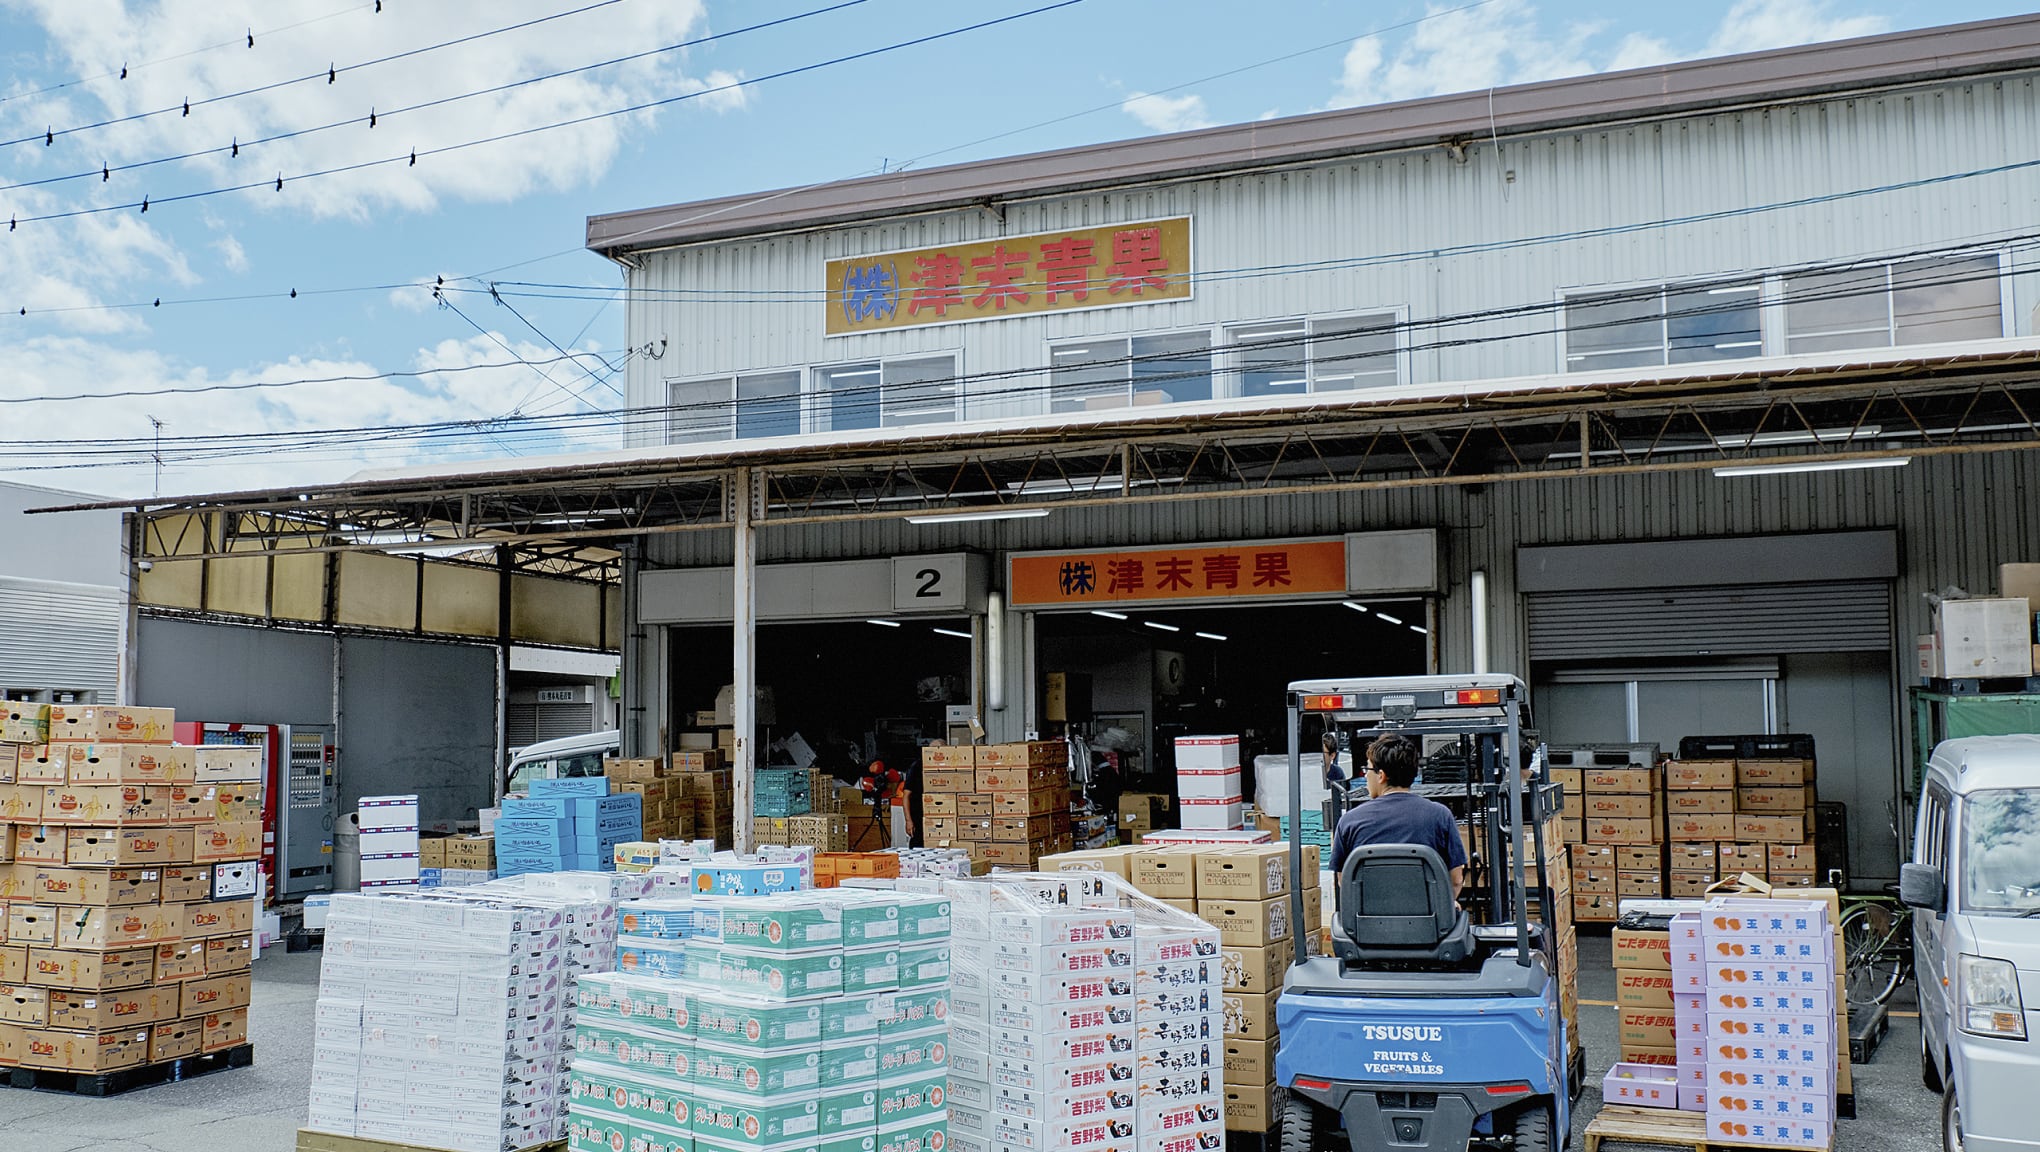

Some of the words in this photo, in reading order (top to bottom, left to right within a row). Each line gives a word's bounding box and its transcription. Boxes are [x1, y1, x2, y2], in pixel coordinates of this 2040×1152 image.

[915, 568, 942, 598] 2
[134, 840, 156, 850] Dole
[110, 871, 128, 880] Dole
[165, 869, 182, 877] Dole
[47, 880, 68, 891] Dole
[196, 912, 217, 924] Dole
[1746, 918, 1808, 930] 玉東梨
[1070, 926, 1104, 942] 吉野梨
[209, 940, 224, 949] Dole
[1750, 944, 1811, 956] 玉東梨
[1160, 943, 1192, 960] 吉野梨
[103, 954, 120, 963] Dole
[1068, 954, 1103, 970] 吉野梨
[39, 960, 60, 972] Dole
[1752, 970, 1814, 983] 玉東梨
[52, 991, 67, 1001] Dole
[197, 990, 217, 1002] Dole
[1068, 983, 1104, 1000] 吉野梨
[115, 1002, 138, 1015] Dole
[1752, 996, 1814, 1009] 玉東梨
[1069, 1011, 1104, 1029] 吉野梨
[156, 1026, 172, 1036] Dole
[1363, 1025, 1442, 1042] TSUSUE
[1753, 1022, 1815, 1036] 玉東梨
[98, 1035, 116, 1045] Dole
[32, 1041, 54, 1053] Dole
[1070, 1039, 1105, 1058] 吉野梨
[1373, 1050, 1419, 1062] FRUITS
[1421, 1050, 1432, 1063] &
[1752, 1048, 1814, 1062] 玉東梨
[1363, 1063, 1444, 1076] VEGETABLES
[1071, 1069, 1105, 1088] 吉野梨
[1752, 1074, 1814, 1088] 玉東梨
[1071, 1097, 1106, 1116] 吉野梨
[1752, 1100, 1814, 1114] 玉東梨
[1163, 1110, 1194, 1129] 吉野梨
[1071, 1126, 1105, 1146] 吉野梨
[1752, 1125, 1815, 1140] 玉東梨
